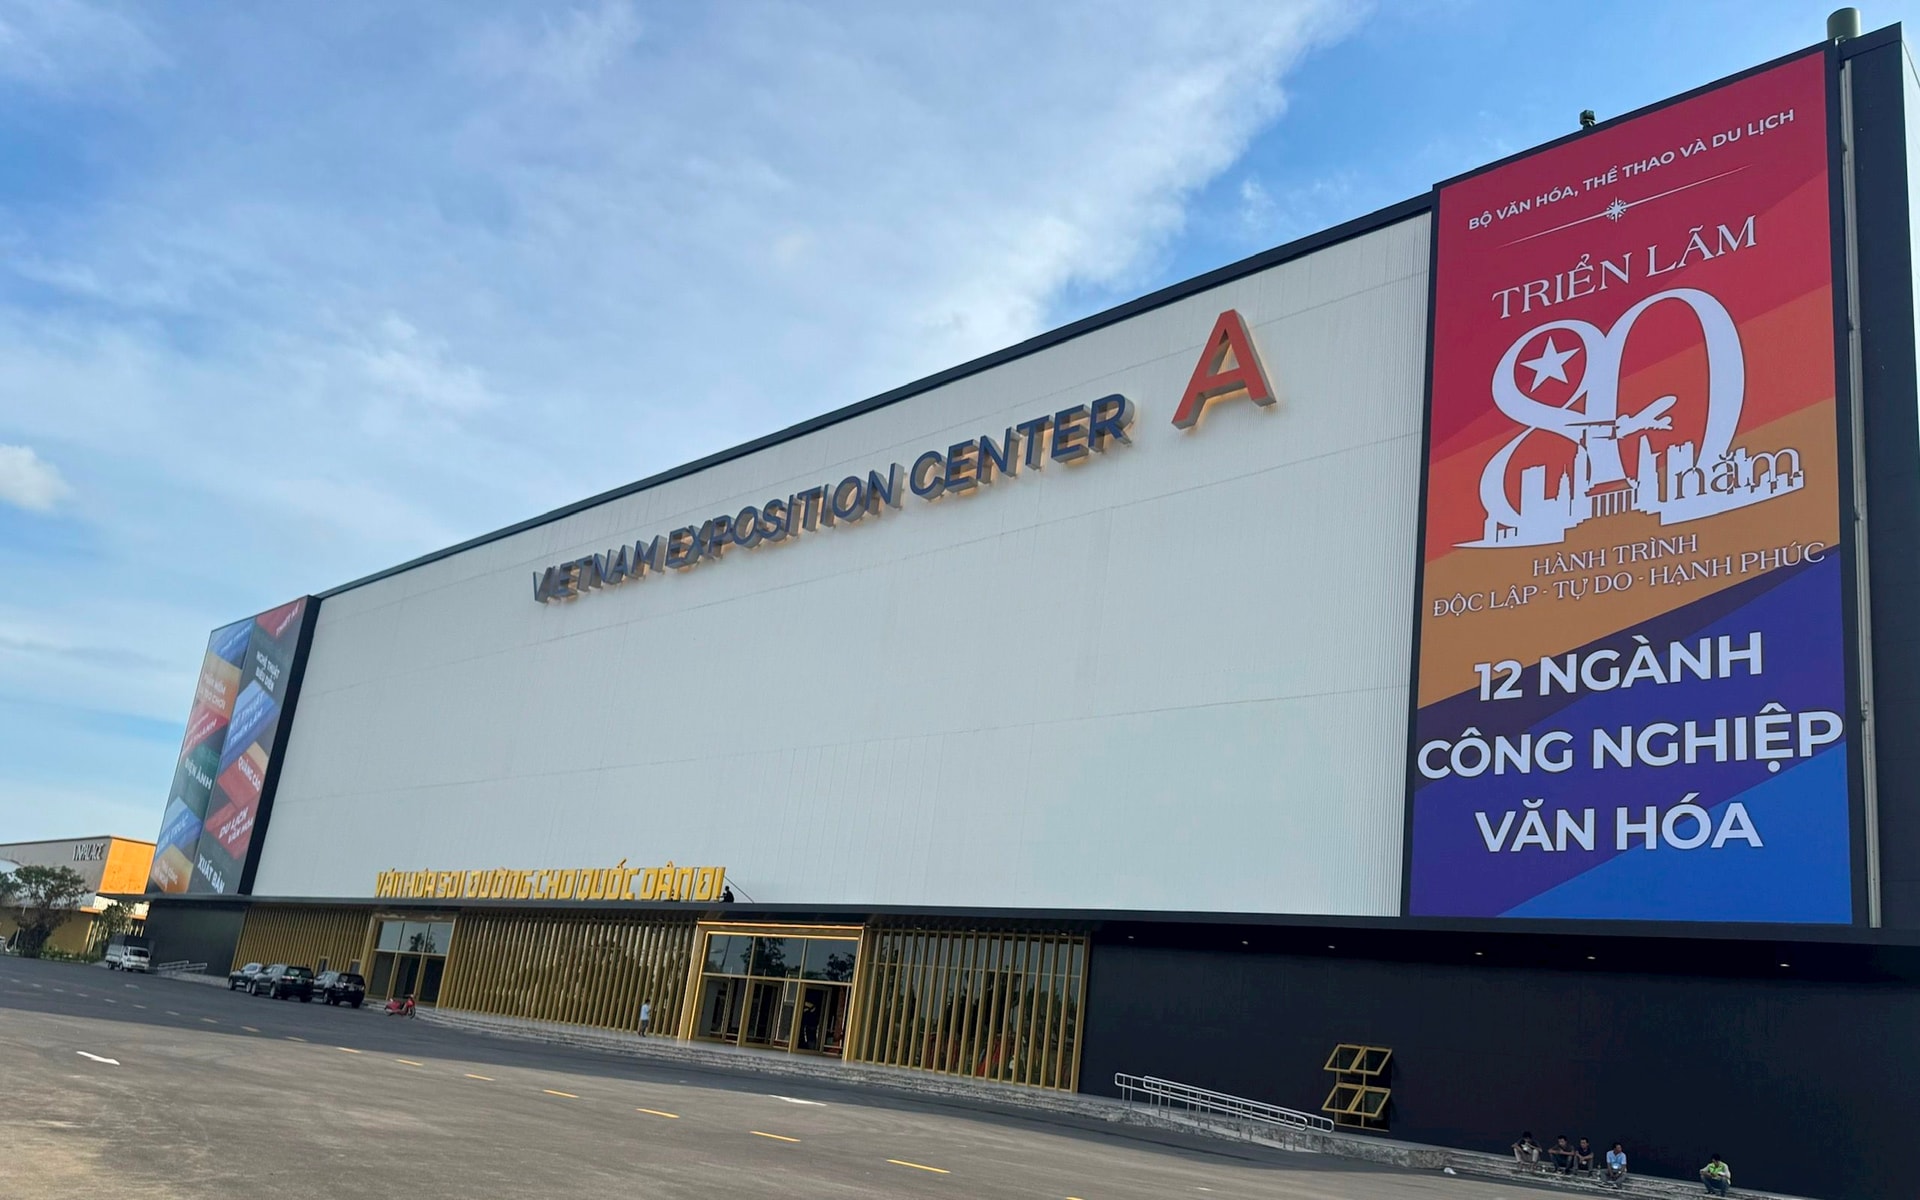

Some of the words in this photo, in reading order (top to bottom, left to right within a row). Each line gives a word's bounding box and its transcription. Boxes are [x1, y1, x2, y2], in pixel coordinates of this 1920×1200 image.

[1468, 209, 1493, 231] BỘ
[1496, 195, 1531, 221] VĂN
[1535, 182, 1579, 206] HÓA,
[1583, 164, 1618, 192] THỂ
[1622, 149, 1676, 179] THAO
[1680, 138, 1708, 158] VÀ
[1712, 127, 1742, 149] DU
[1747, 108, 1796, 137] LỊCH
[1491, 251, 1633, 320] TRIỂN
[1646, 214, 1758, 278] LÃM
[1171, 308, 1277, 430] A
[532, 535, 668, 603] VIETNAM
[665, 463, 904, 570] EXPOSITION
[909, 393, 1134, 501] CENTER
[1432, 592, 1484, 618] ĐỘC
[1488, 583, 1537, 610] LẬP
[1552, 577, 1589, 602] TỰ
[1594, 572, 1633, 595] DO
[1650, 558, 1733, 588] HẠNH
[1739, 540, 1828, 575] PHÚC
[1532, 546, 1607, 577] HÀNH
[1612, 533, 1699, 569] TRÌNH
[1473, 660, 1523, 702] 12
[1538, 631, 1764, 697] NGÀNH
[1416, 726, 1574, 780] CÔNG
[1592, 701, 1844, 774] NGHIỆP
[1474, 796, 1596, 853] VĂN
[1615, 791, 1765, 851] HÓA
[533, 868, 578, 900] CHO
[577, 857, 640, 901] QUỐC
[640, 860, 695, 901] DÂN
